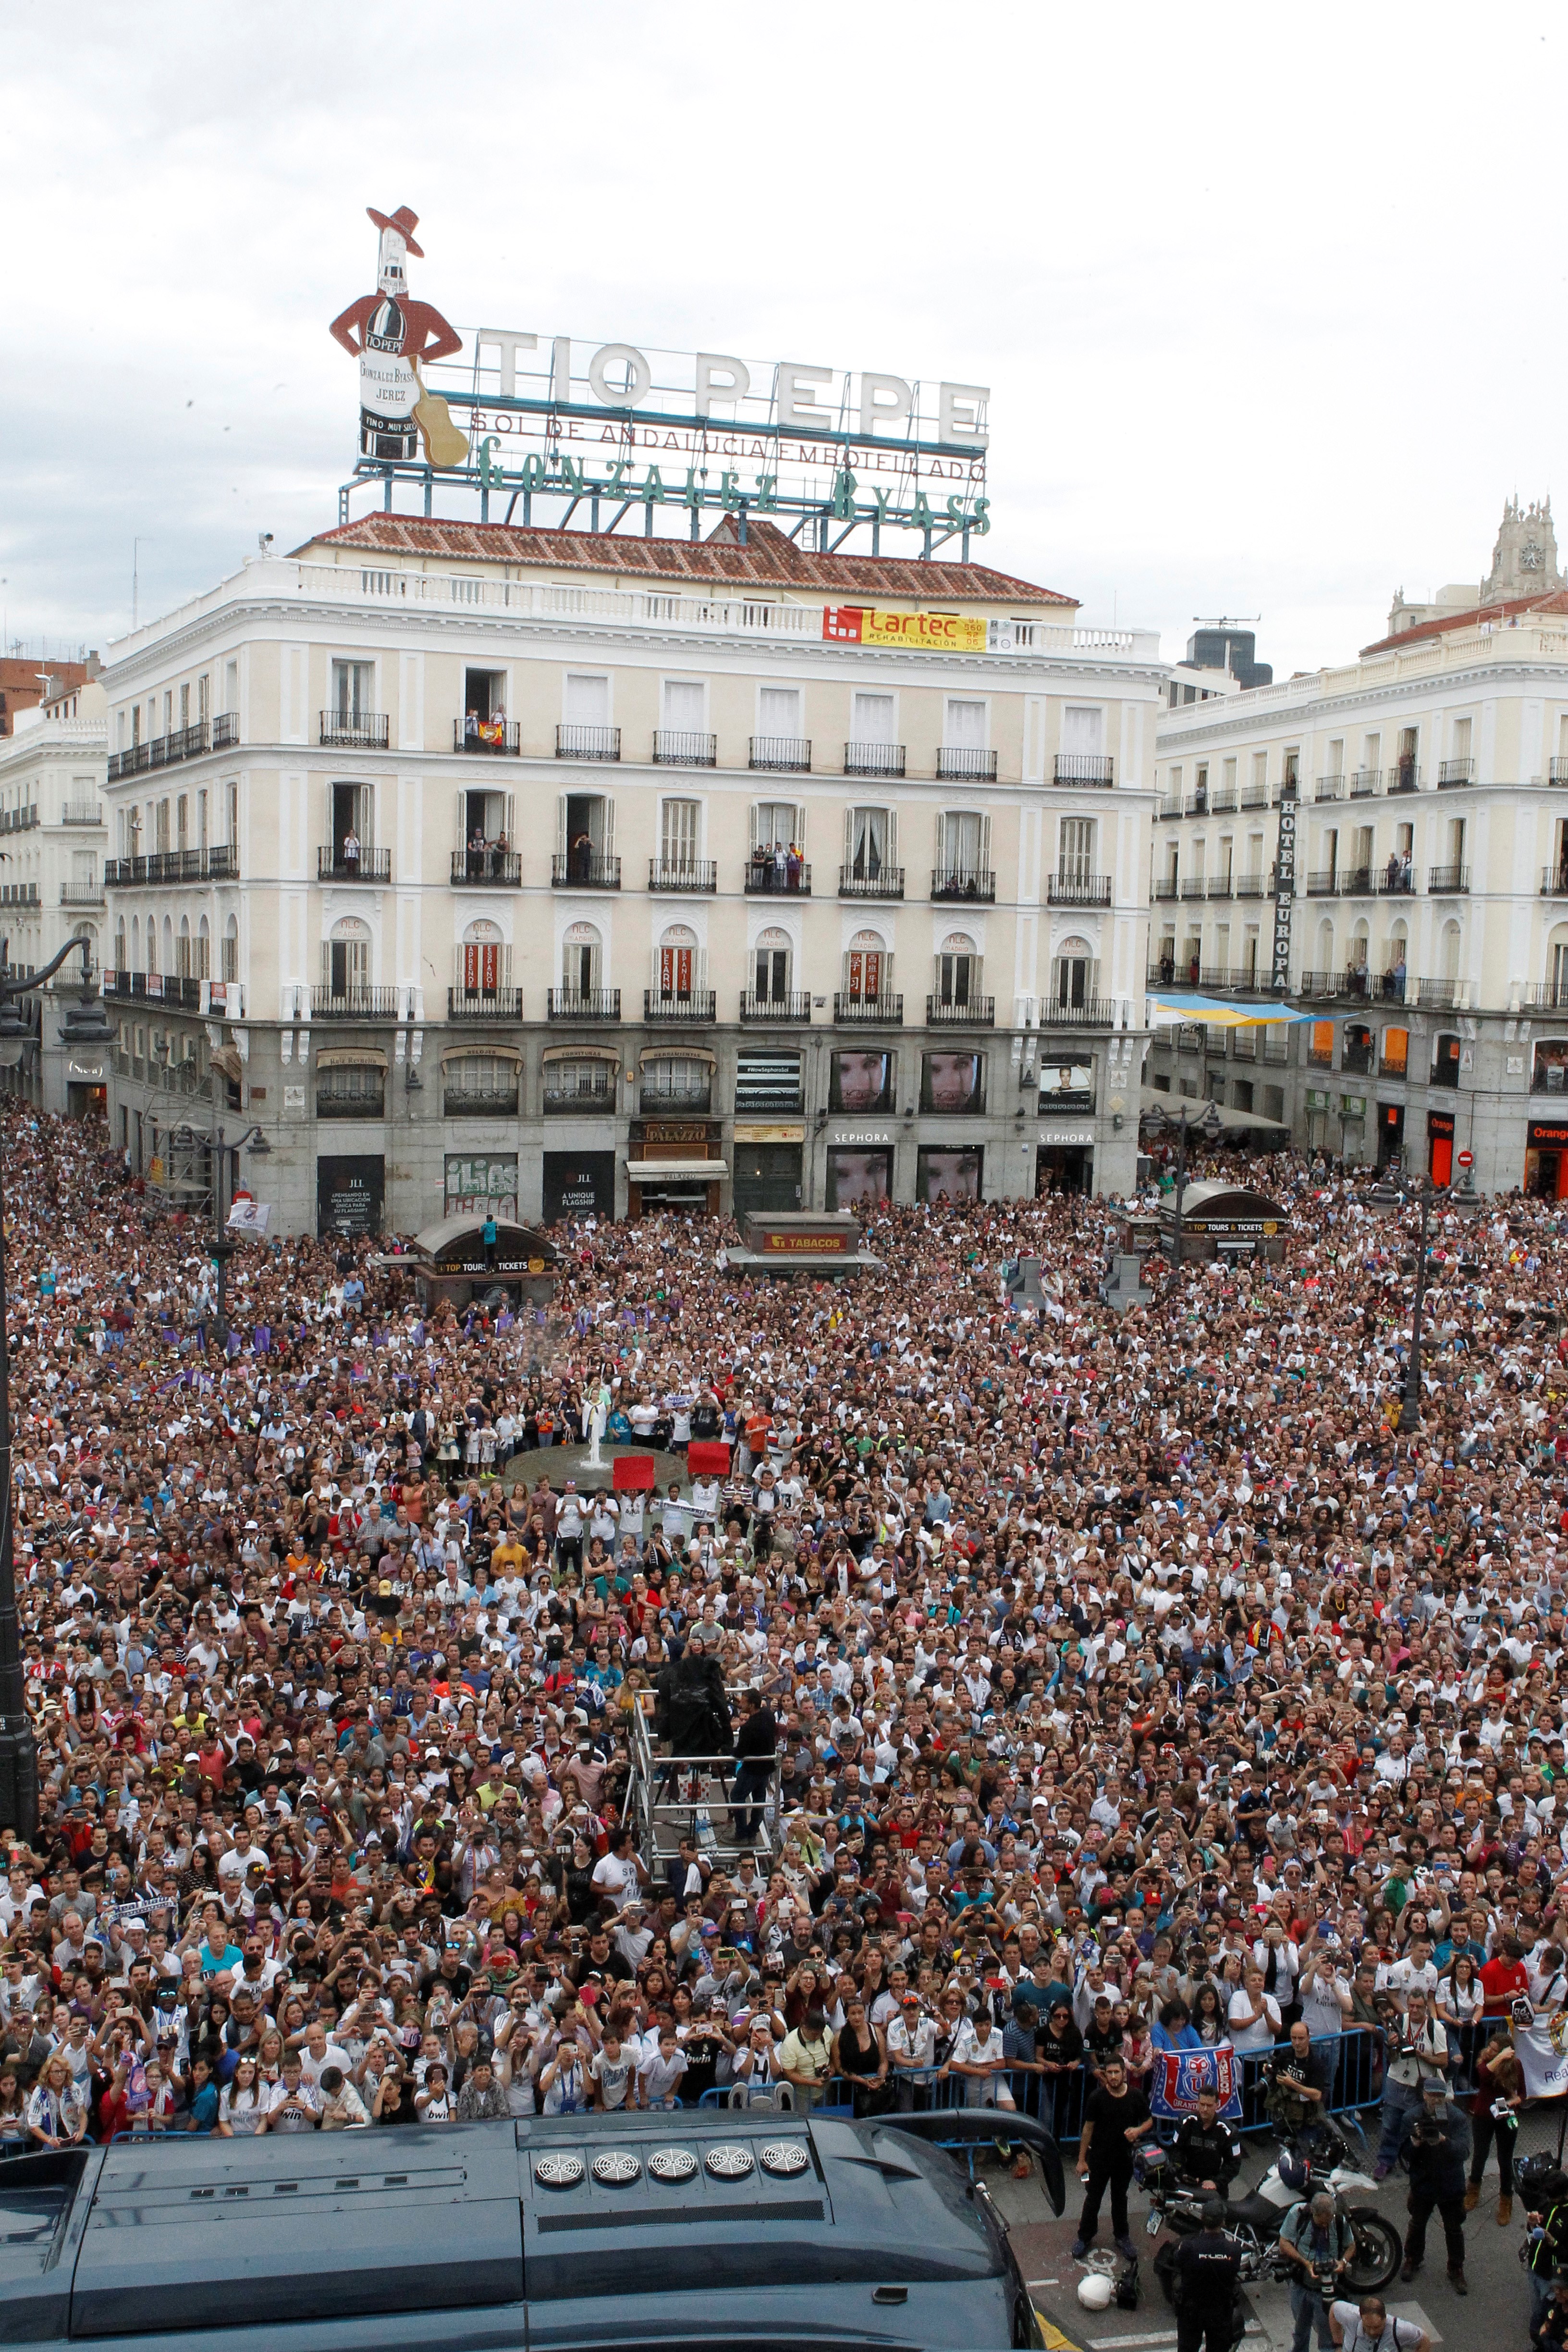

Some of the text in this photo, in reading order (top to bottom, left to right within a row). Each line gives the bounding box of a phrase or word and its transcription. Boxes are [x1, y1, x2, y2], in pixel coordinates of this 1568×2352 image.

[479, 329, 990, 449] TIO PEPE
[376, 388, 406, 402] JEREZ
[388, 423, 402, 432] MUY
[470, 412, 986, 481] SOL DE ANDALUCIA EMBOTELLADO
[478, 436, 991, 536] GONZALEZ BYASS
[869, 633, 957, 647] REHABILITACIÓN
[1274, 800, 1296, 988] HOTEL EUROPA
[1432, 1117, 1453, 1132] Orange
[835, 1134, 889, 1142] SEPHORA
[1040, 1134, 1092, 1142] SEPHORA
[1534, 1127, 1568, 1140] Orang
[349, 1179, 364, 1188] JLL
[577, 1174, 591, 1182] JLL
[790, 1238, 840, 1248] TABACOS
[446, 1264, 461, 1272] TOP
[498, 1262, 527, 1270] TICKETS
[113, 1902, 138, 1913] Real
[686, 2053, 710, 2064] bwin
[1173, 2098, 1198, 2109] GRAND
